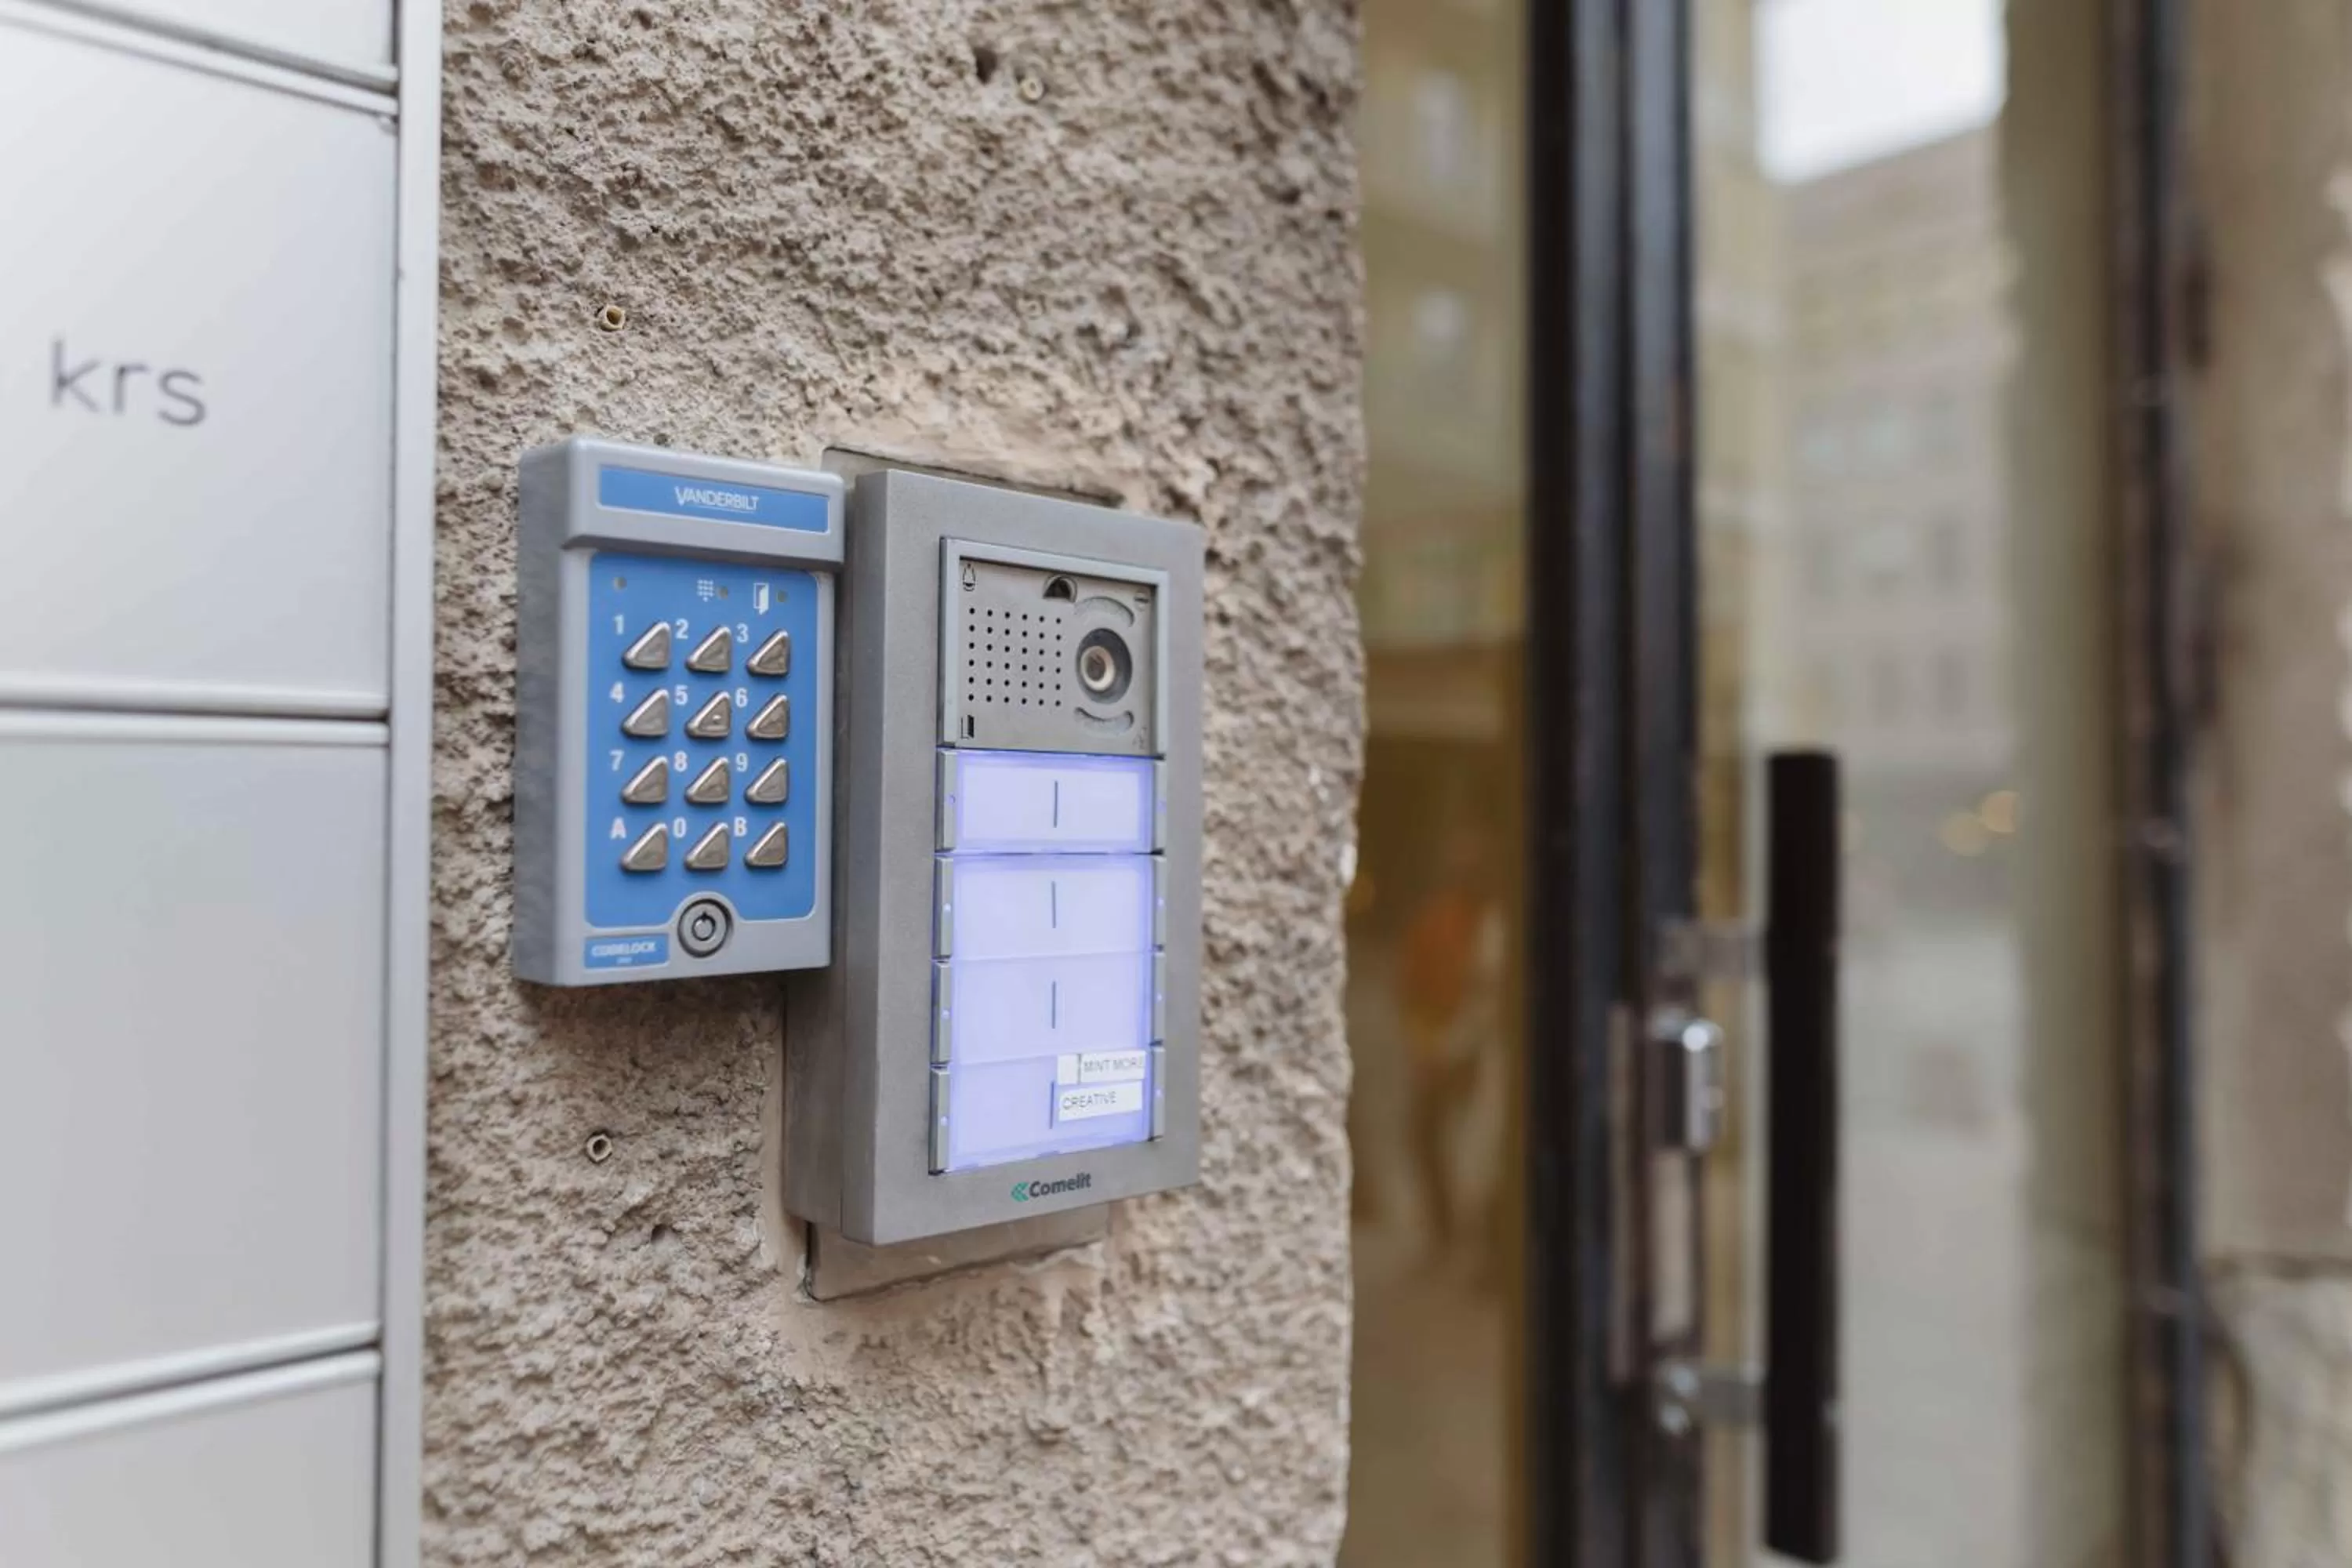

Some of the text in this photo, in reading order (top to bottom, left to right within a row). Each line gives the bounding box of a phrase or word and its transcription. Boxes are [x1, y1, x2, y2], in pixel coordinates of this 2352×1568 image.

[51, 338, 207, 427] krs
[674, 485, 760, 512] VANDERBILT
[614, 615, 749, 644] 1 2 3
[610, 682, 748, 707] 4 5 6
[610, 750, 748, 772] 7 8 9
[611, 818, 626, 839] A
[734, 817, 747, 837] B
[1083, 1059, 1109, 1073] MINT
[1062, 1091, 1116, 1109] CREATIVE
[1029, 1172, 1092, 1198] Comelit
